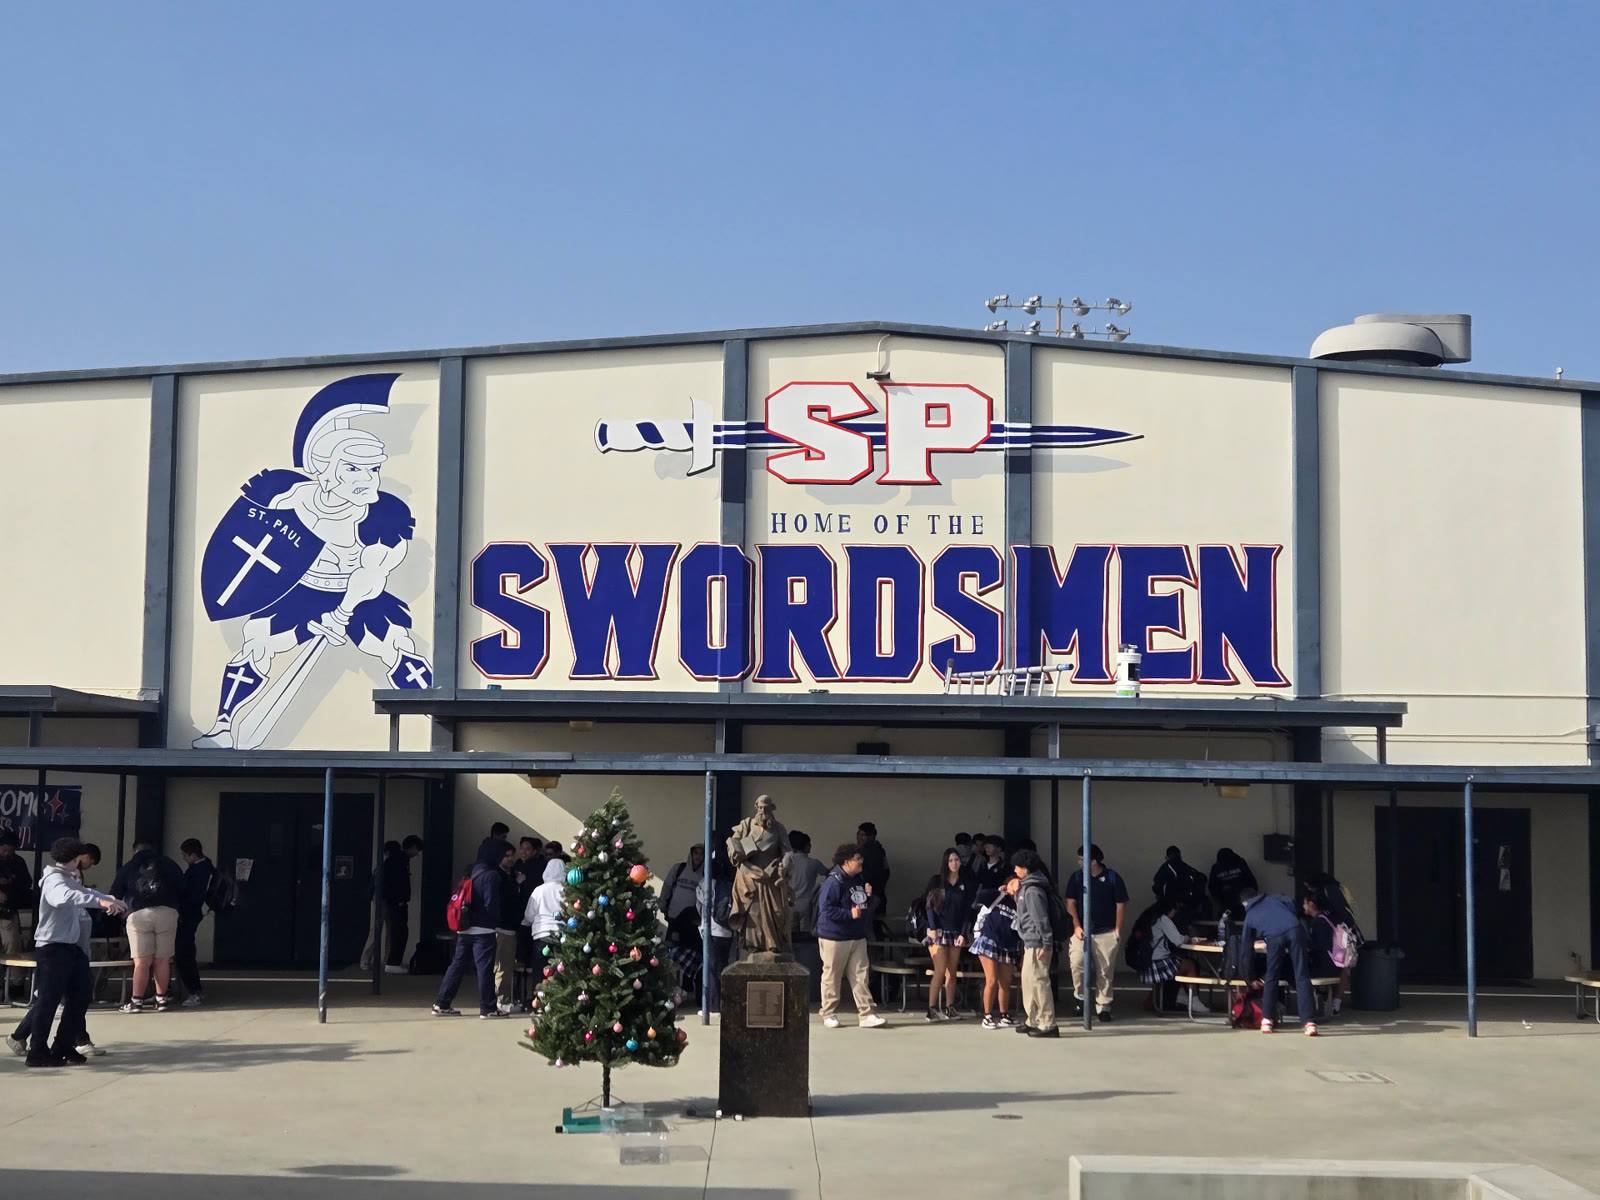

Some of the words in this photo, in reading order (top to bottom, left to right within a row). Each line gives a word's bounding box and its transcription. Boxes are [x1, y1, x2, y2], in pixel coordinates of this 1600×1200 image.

[764, 381, 994, 485] SP
[247, 507, 269, 525] ST.
[272, 518, 302, 549] PAUL
[771, 512, 851, 534] HOME
[873, 513, 910, 535] OF
[927, 514, 984, 535] THE
[469, 540, 1292, 688] SWORDSMEN
